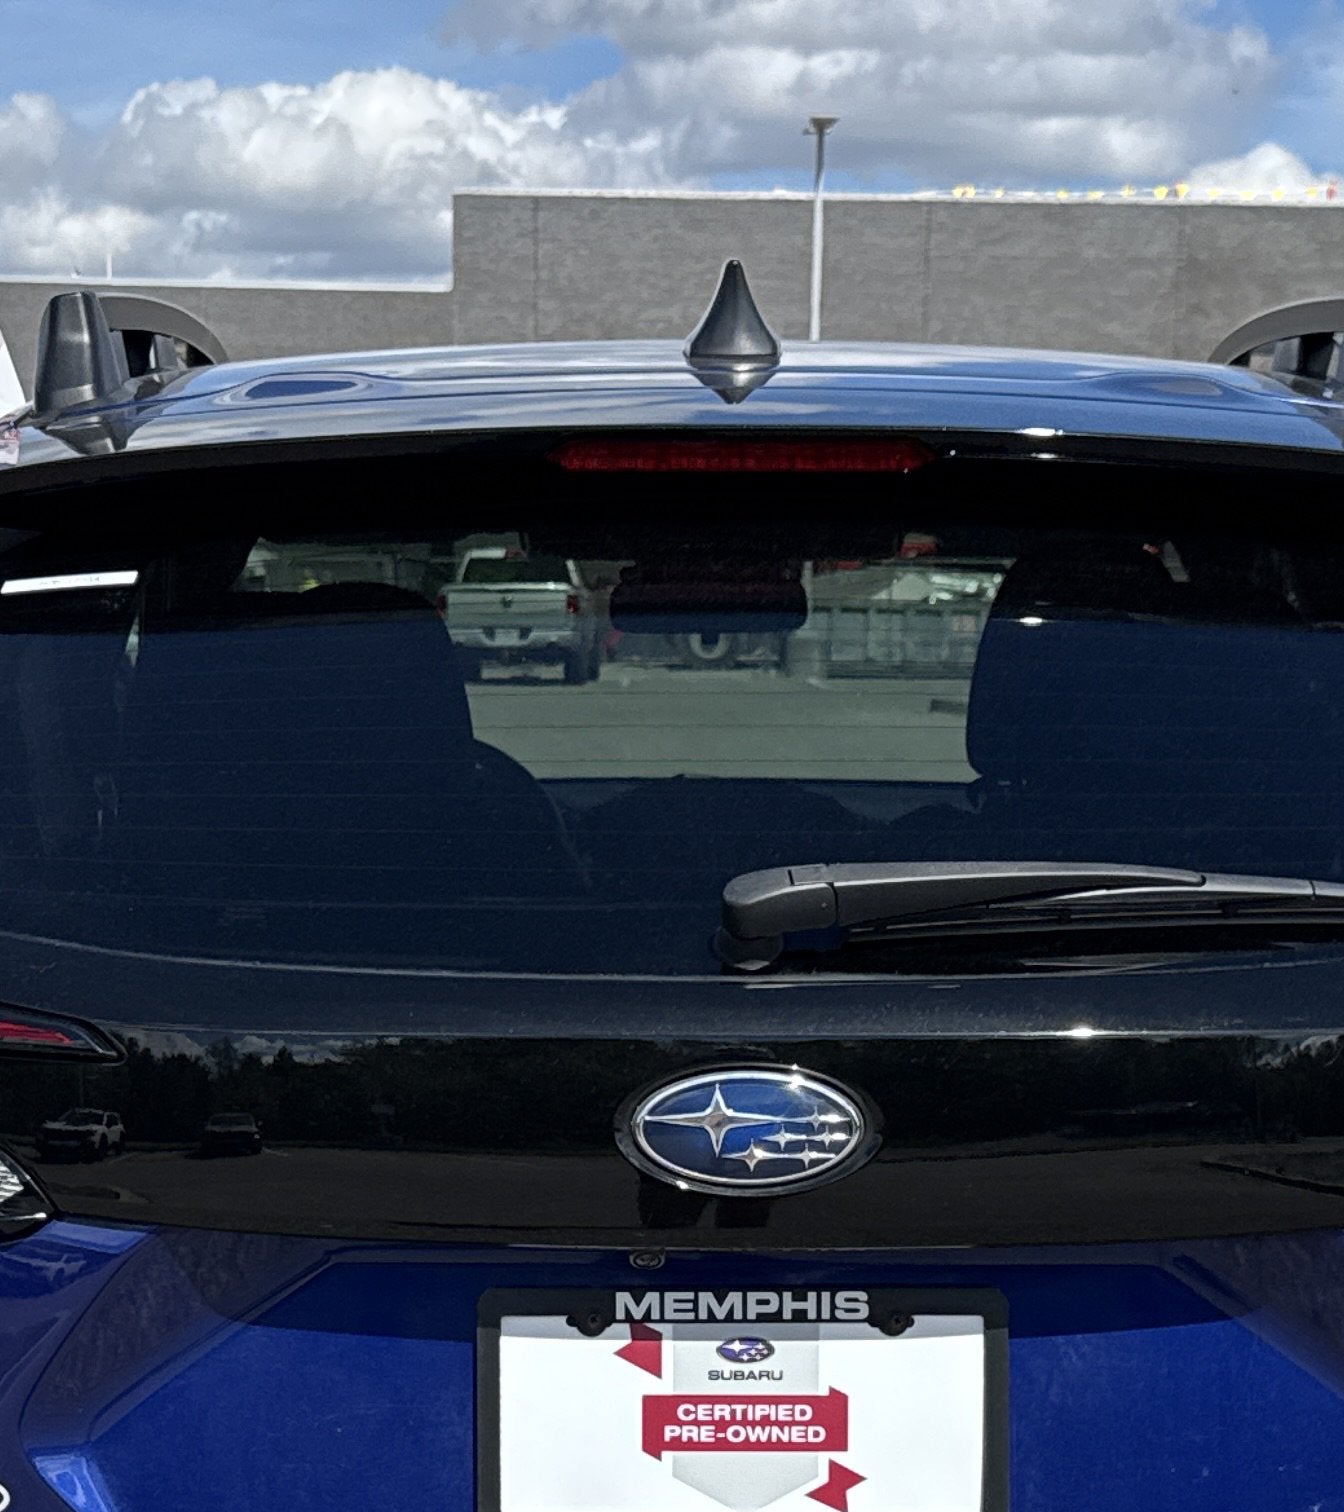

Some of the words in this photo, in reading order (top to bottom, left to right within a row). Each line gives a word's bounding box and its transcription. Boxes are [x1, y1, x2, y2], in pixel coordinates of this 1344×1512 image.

[614, 1290, 870, 1321] MEMPHIS
[707, 1369, 784, 1381] SUBARU
[676, 1403, 814, 1422] CERTIFIED
[663, 1424, 827, 1443] PRE-OWNED
